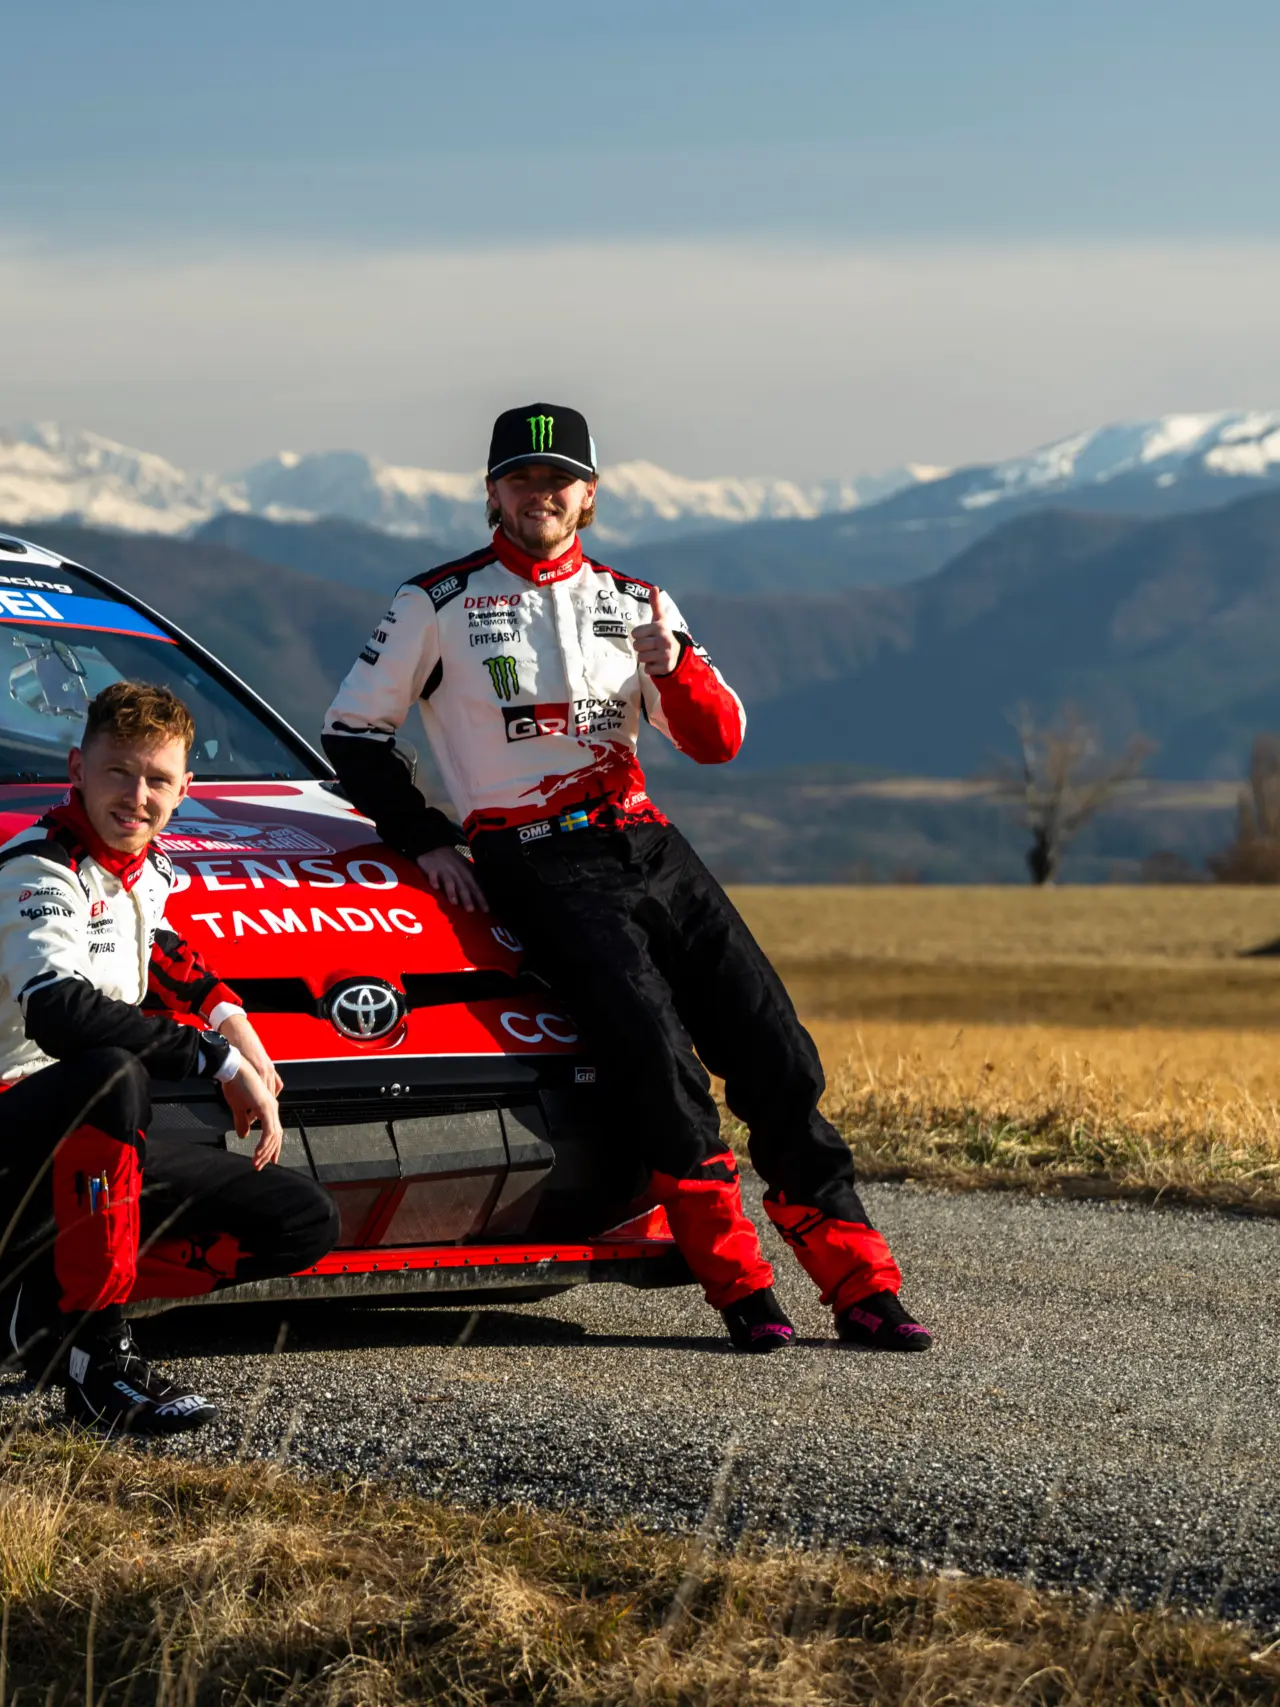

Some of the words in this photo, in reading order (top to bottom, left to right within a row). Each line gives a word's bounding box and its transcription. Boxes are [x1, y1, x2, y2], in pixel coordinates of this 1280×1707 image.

[431, 578, 458, 599] OMP
[464, 594, 520, 609] DENSO
[468, 611, 516, 620] Panasonic
[468, 618, 519, 628] AUTOMOTIVE
[508, 717, 566, 740] GR
[575, 719, 622, 737] Racin
[520, 824, 551, 840] OMP
[20, 905, 61, 920] Mobil
[190, 907, 423, 938] TAMADIC
